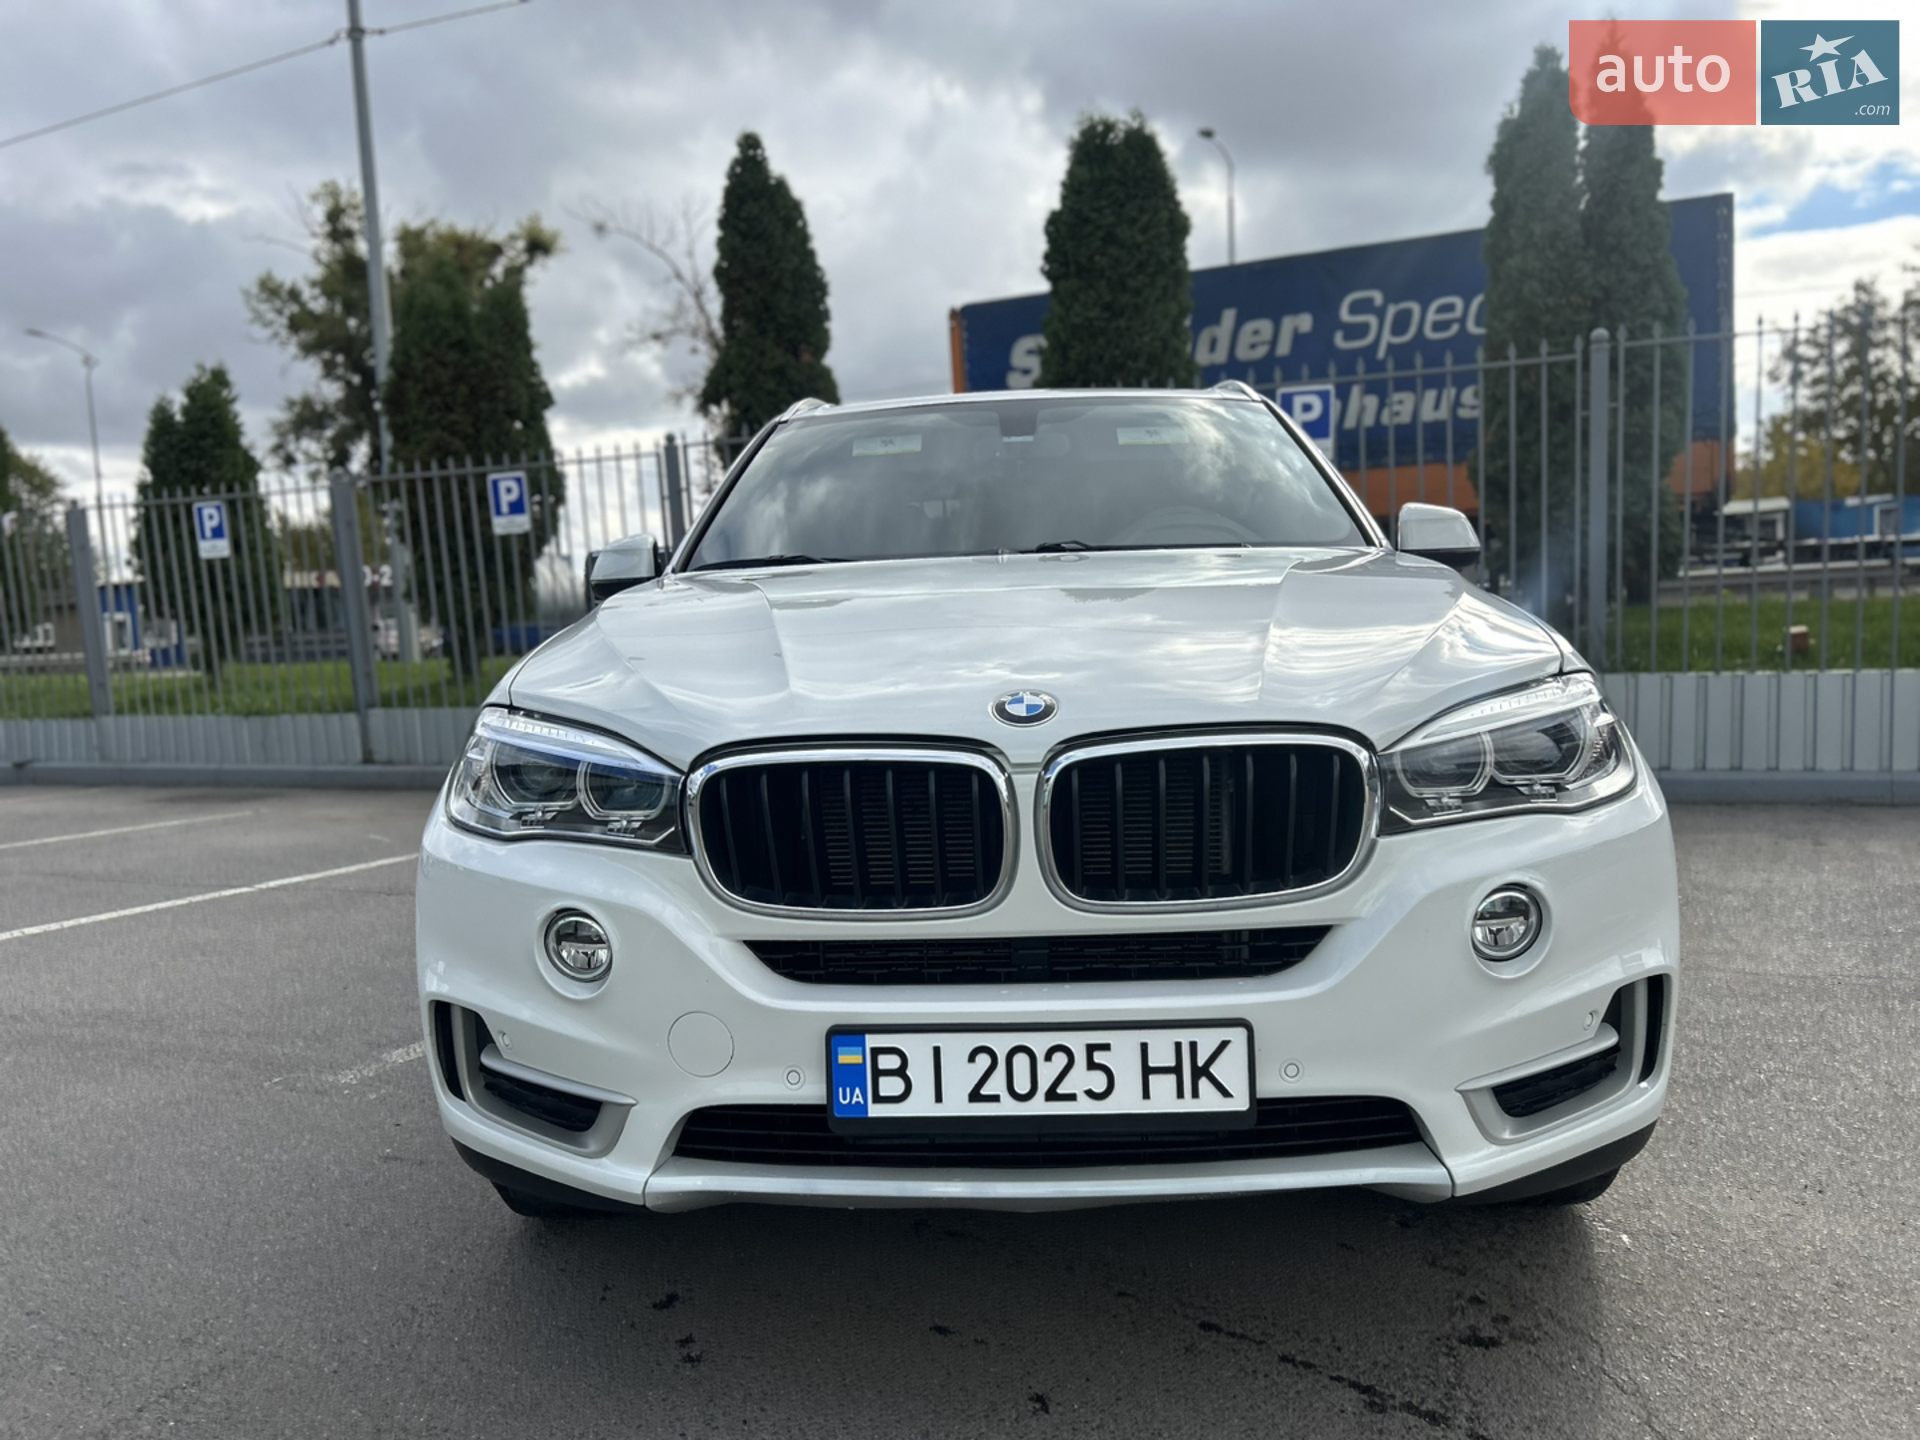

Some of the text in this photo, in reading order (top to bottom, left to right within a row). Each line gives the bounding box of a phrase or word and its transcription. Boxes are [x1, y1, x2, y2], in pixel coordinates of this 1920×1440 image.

[1292, 393, 1323, 428] P
[497, 479, 521, 515] P
[201, 506, 221, 539] P
[869, 1039, 1235, 1104] BI 2025 HK
[838, 1086, 865, 1105] UA
